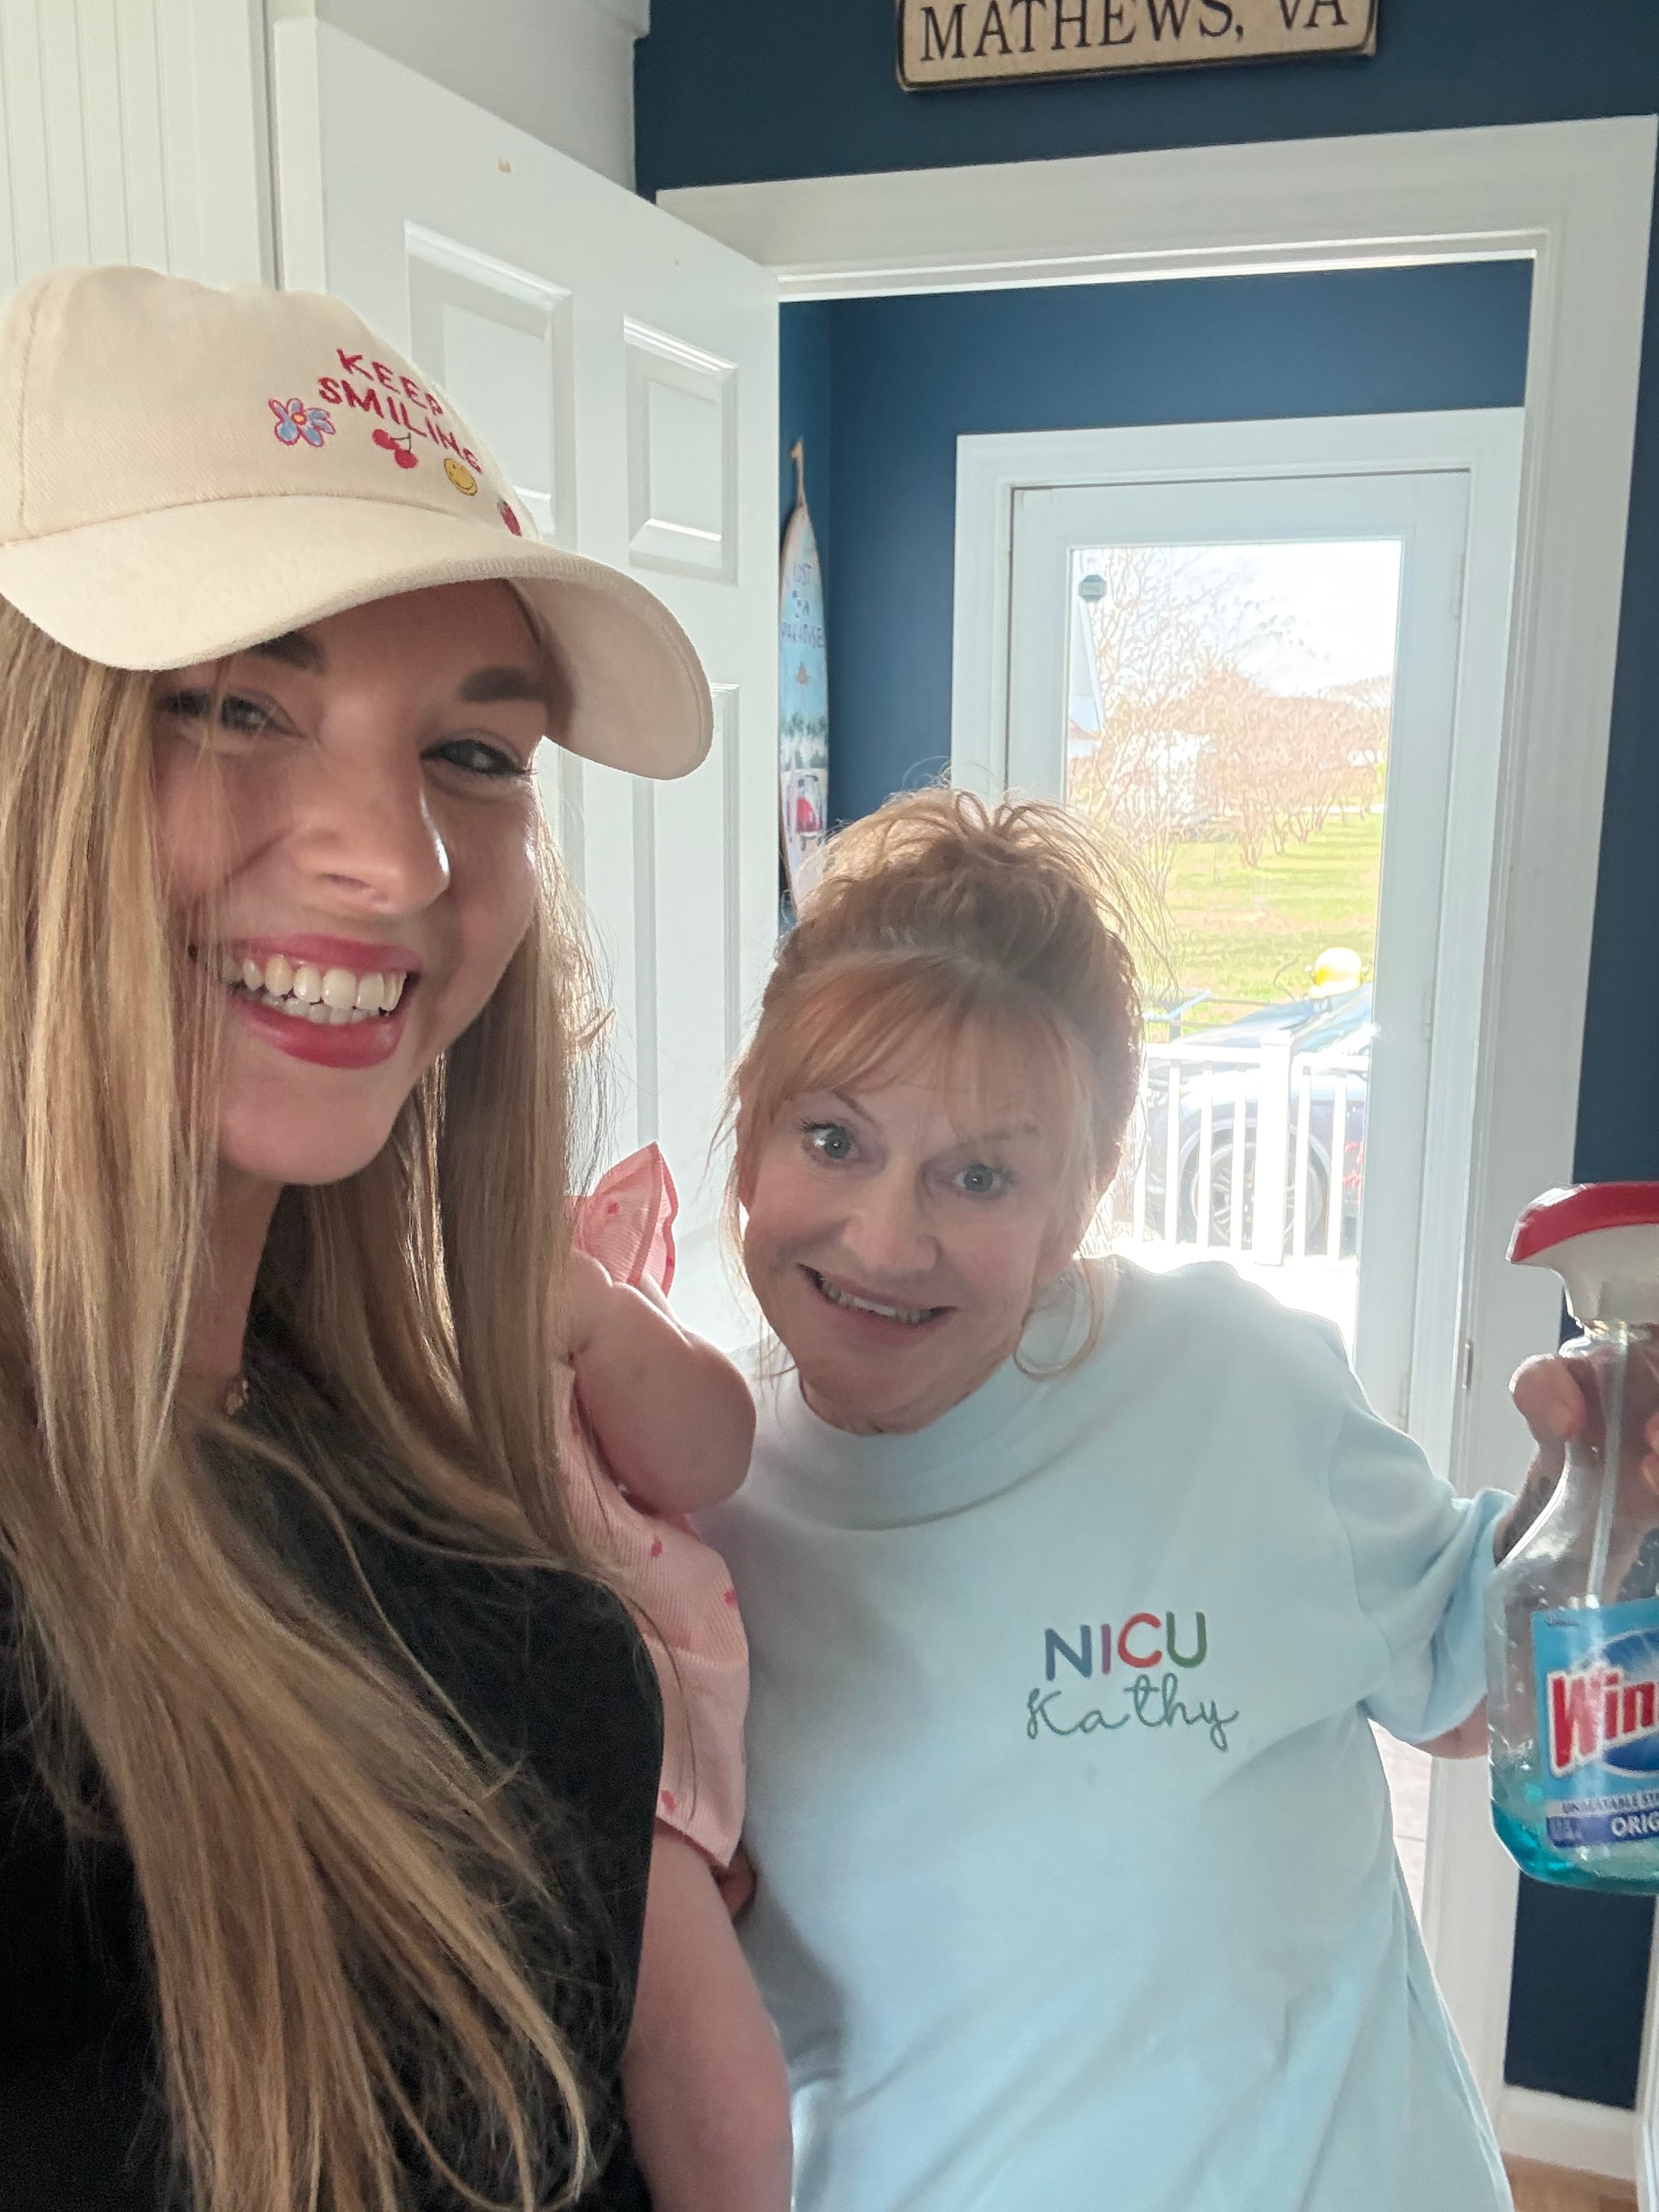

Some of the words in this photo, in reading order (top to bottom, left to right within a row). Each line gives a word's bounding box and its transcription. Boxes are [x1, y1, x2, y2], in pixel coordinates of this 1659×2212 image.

[920, 0, 1244, 62] MATHEWS,
[1279, 0, 1348, 30] VA
[336, 347, 443, 416] KEEP
[317, 376, 483, 474] SMILING
[1044, 1610, 1208, 1681] NICU
[1026, 1673, 1240, 1752] Kathy
